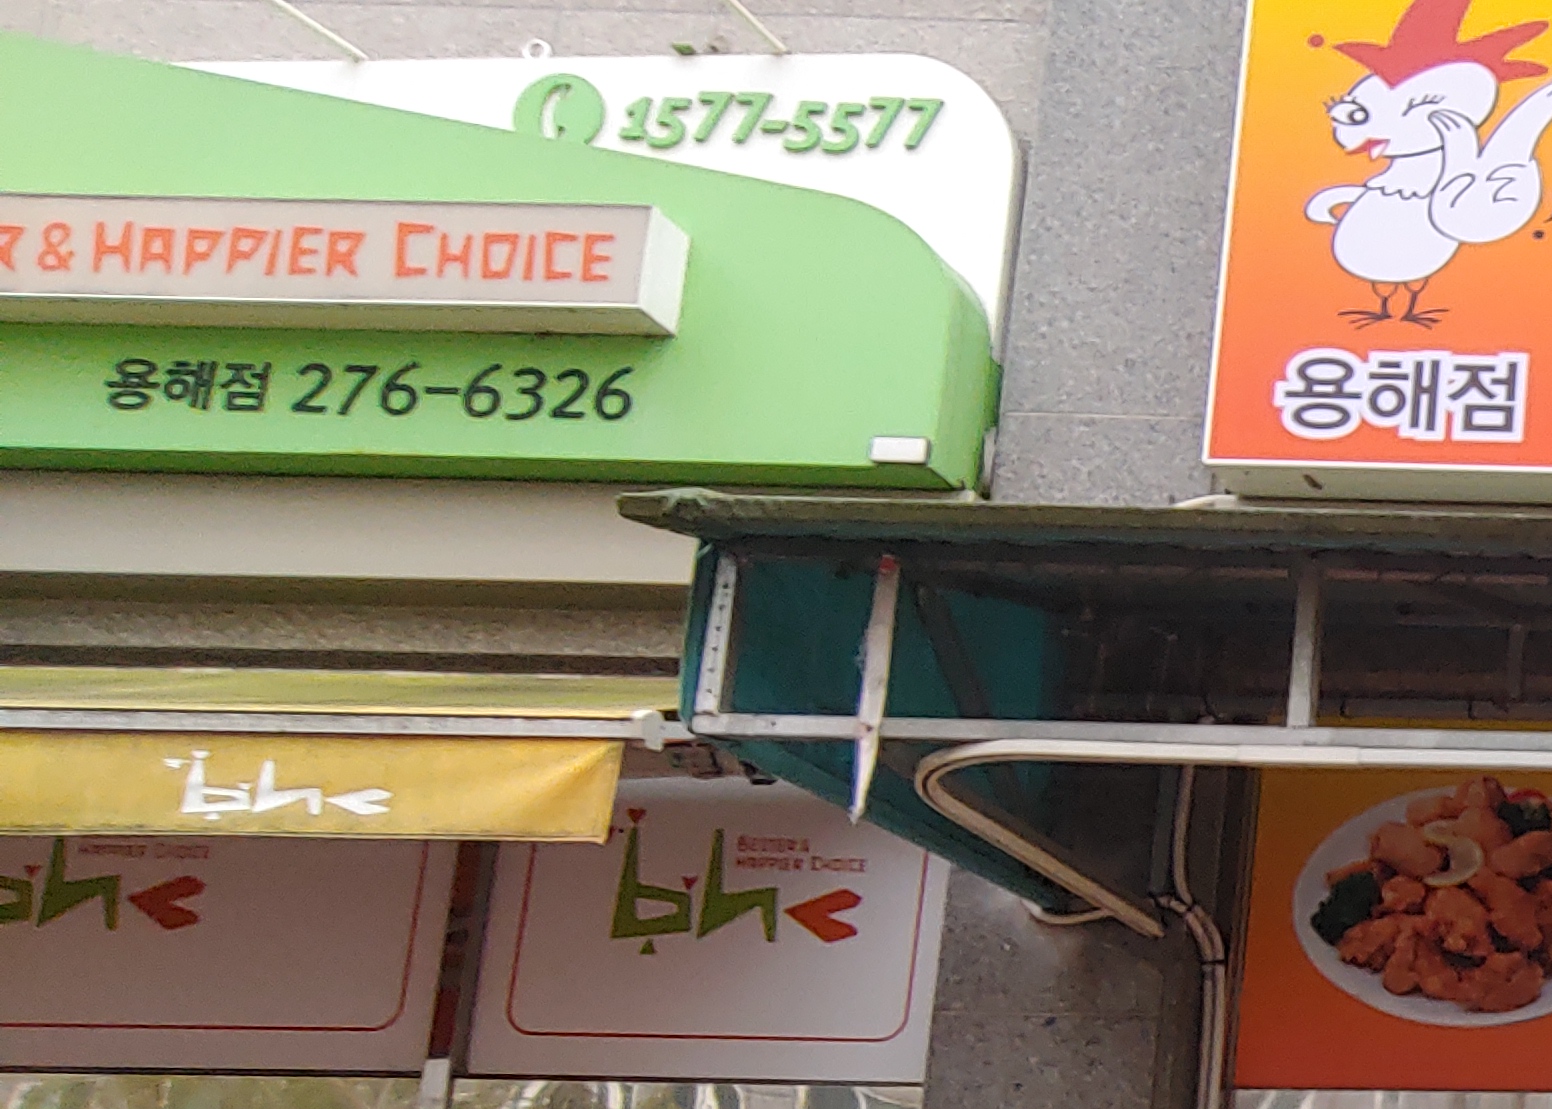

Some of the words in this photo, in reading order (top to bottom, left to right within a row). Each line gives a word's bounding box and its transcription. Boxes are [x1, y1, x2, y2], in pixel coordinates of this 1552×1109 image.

[619, 91, 944, 154] 1577-5577
[37, 222, 75, 272] &
[92, 221, 366, 277] HAPPIER
[394, 221, 615, 282] CHOICE
[106, 358, 272, 413] 용해점
[291, 361, 636, 421] 276-6326
[1284, 358, 1520, 437] 용해점
